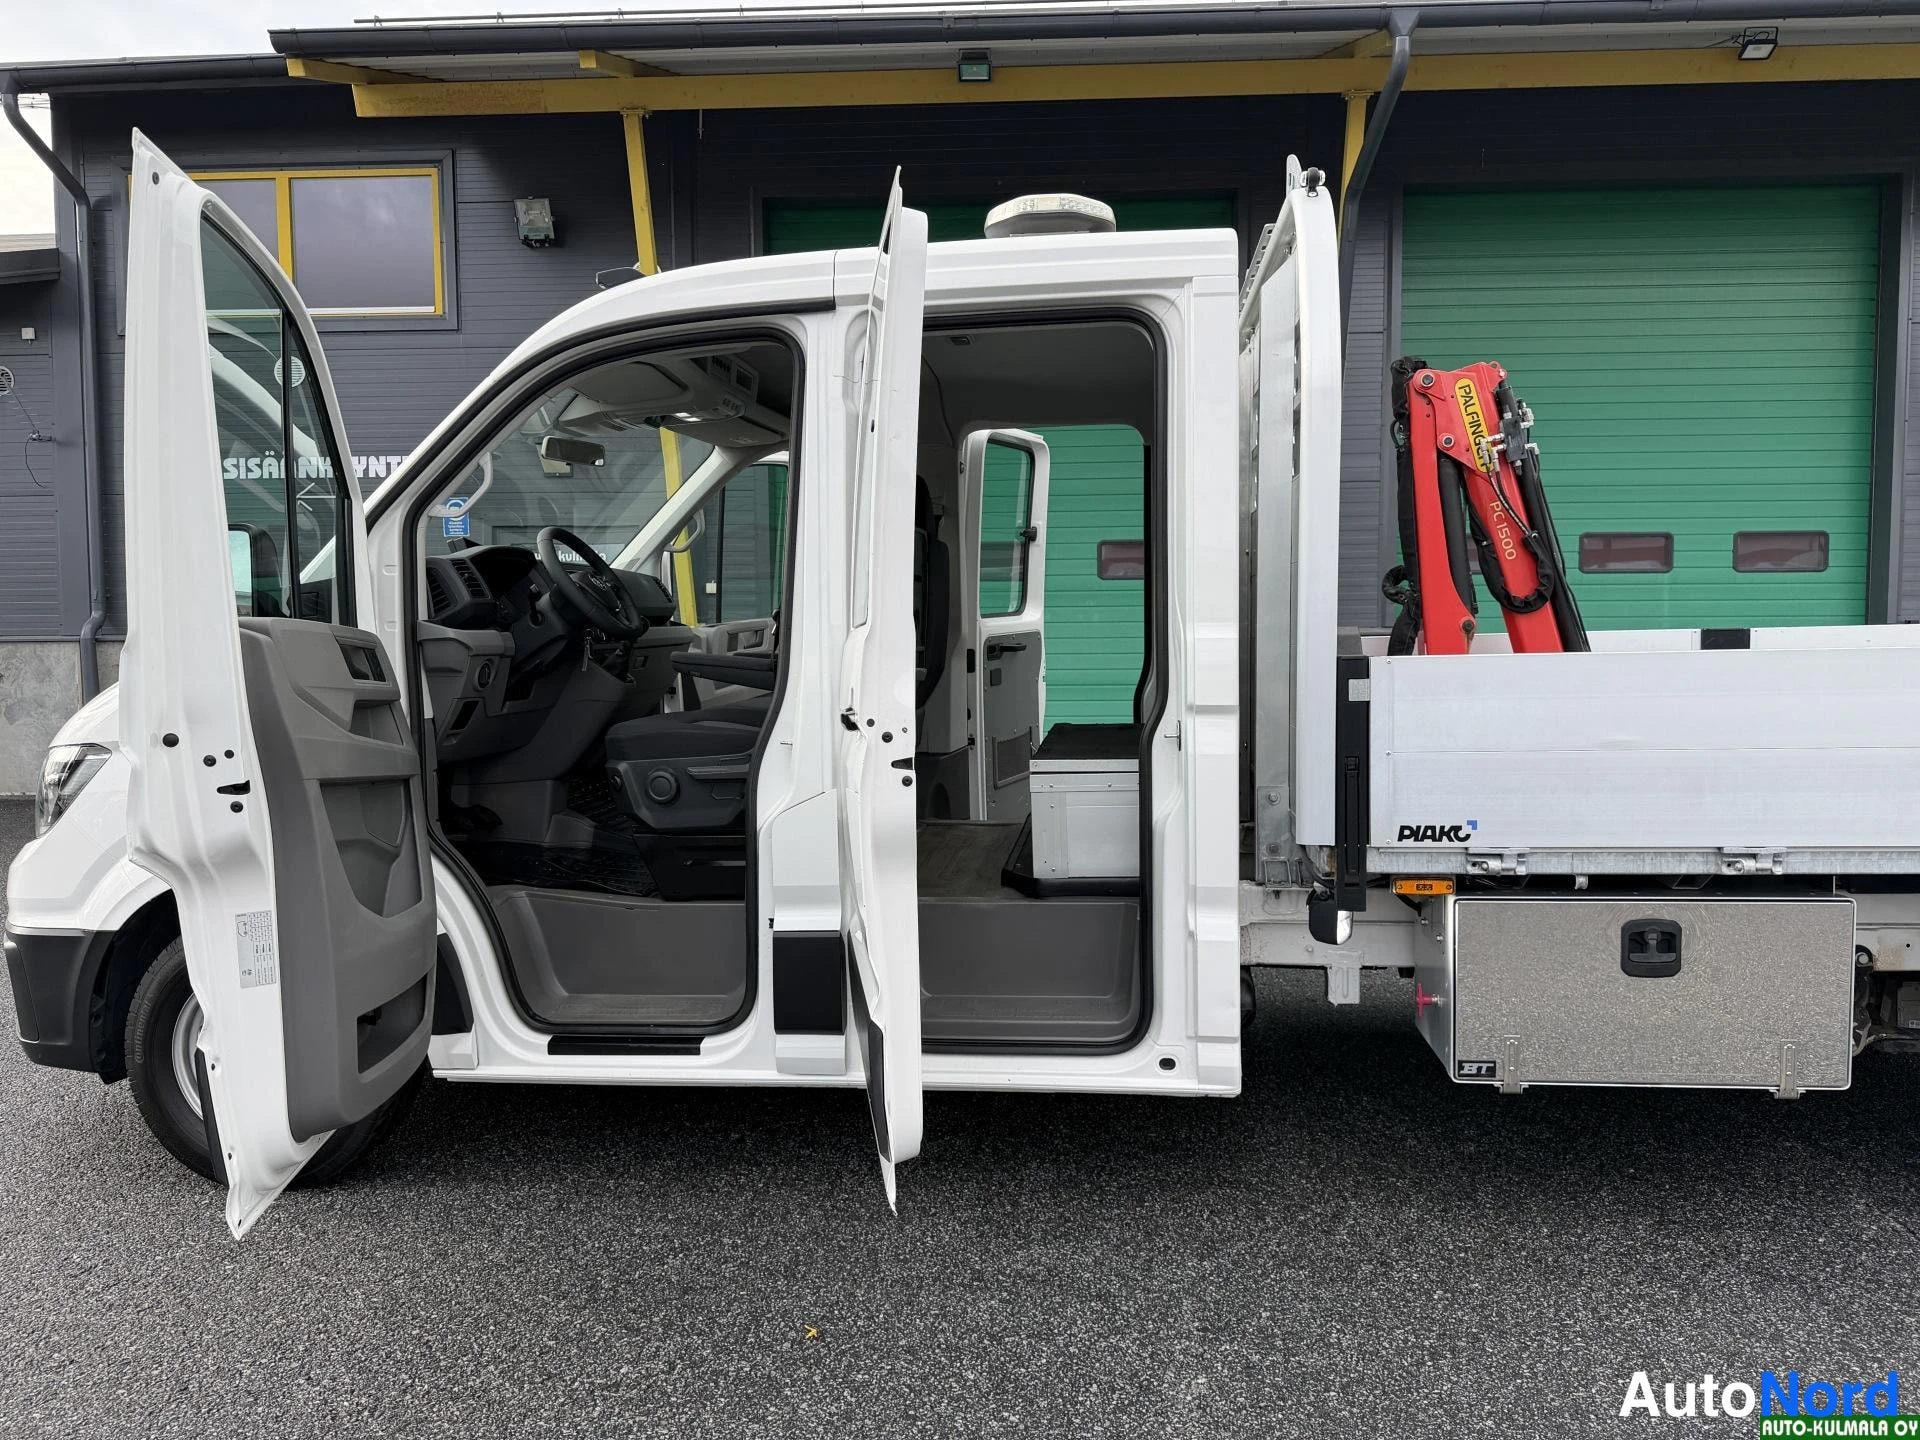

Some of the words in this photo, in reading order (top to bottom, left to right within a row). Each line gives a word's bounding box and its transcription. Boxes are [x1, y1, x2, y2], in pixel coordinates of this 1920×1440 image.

[1490, 501, 1505, 521] PC
[1496, 522, 1517, 560] 1500
[1397, 820, 1477, 842] PIAKO
[1459, 1062, 1495, 1075] BT
